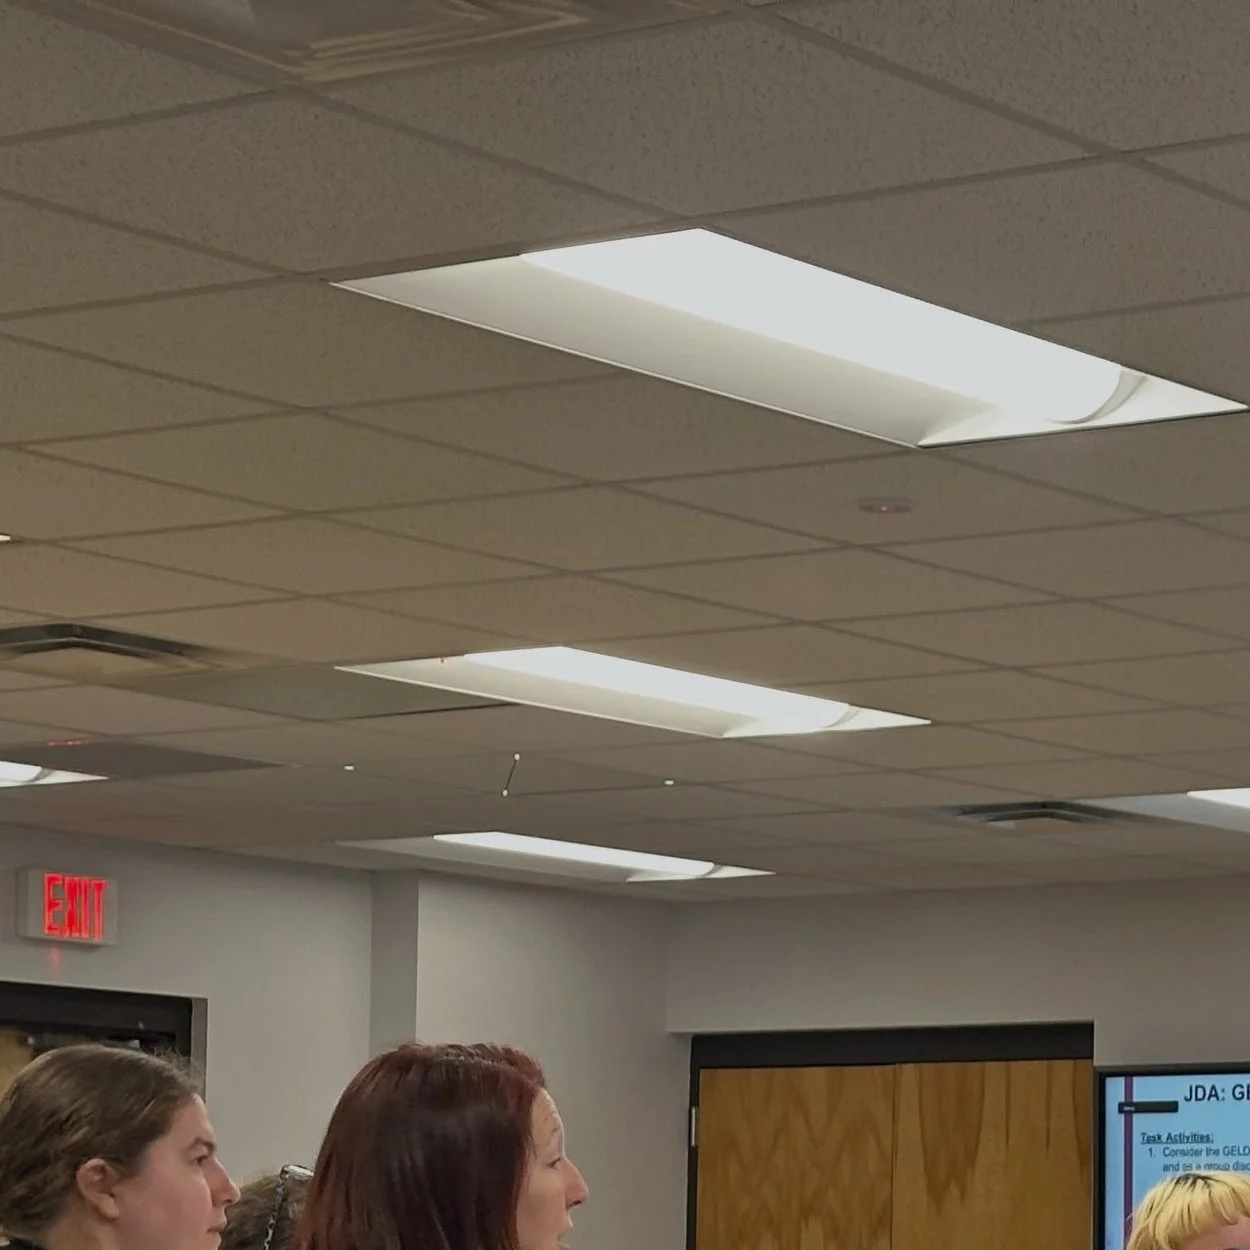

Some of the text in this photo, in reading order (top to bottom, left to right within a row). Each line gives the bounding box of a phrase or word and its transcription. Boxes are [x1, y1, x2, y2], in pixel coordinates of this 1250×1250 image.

[44, 873, 108, 943] EXIT
[1184, 1084, 1226, 1102] JDA:
[1140, 1132, 1162, 1144] Task
[1162, 1146, 1202, 1157] Consider
[1205, 1146, 1220, 1157] the
[1162, 1161, 1180, 1172] and
